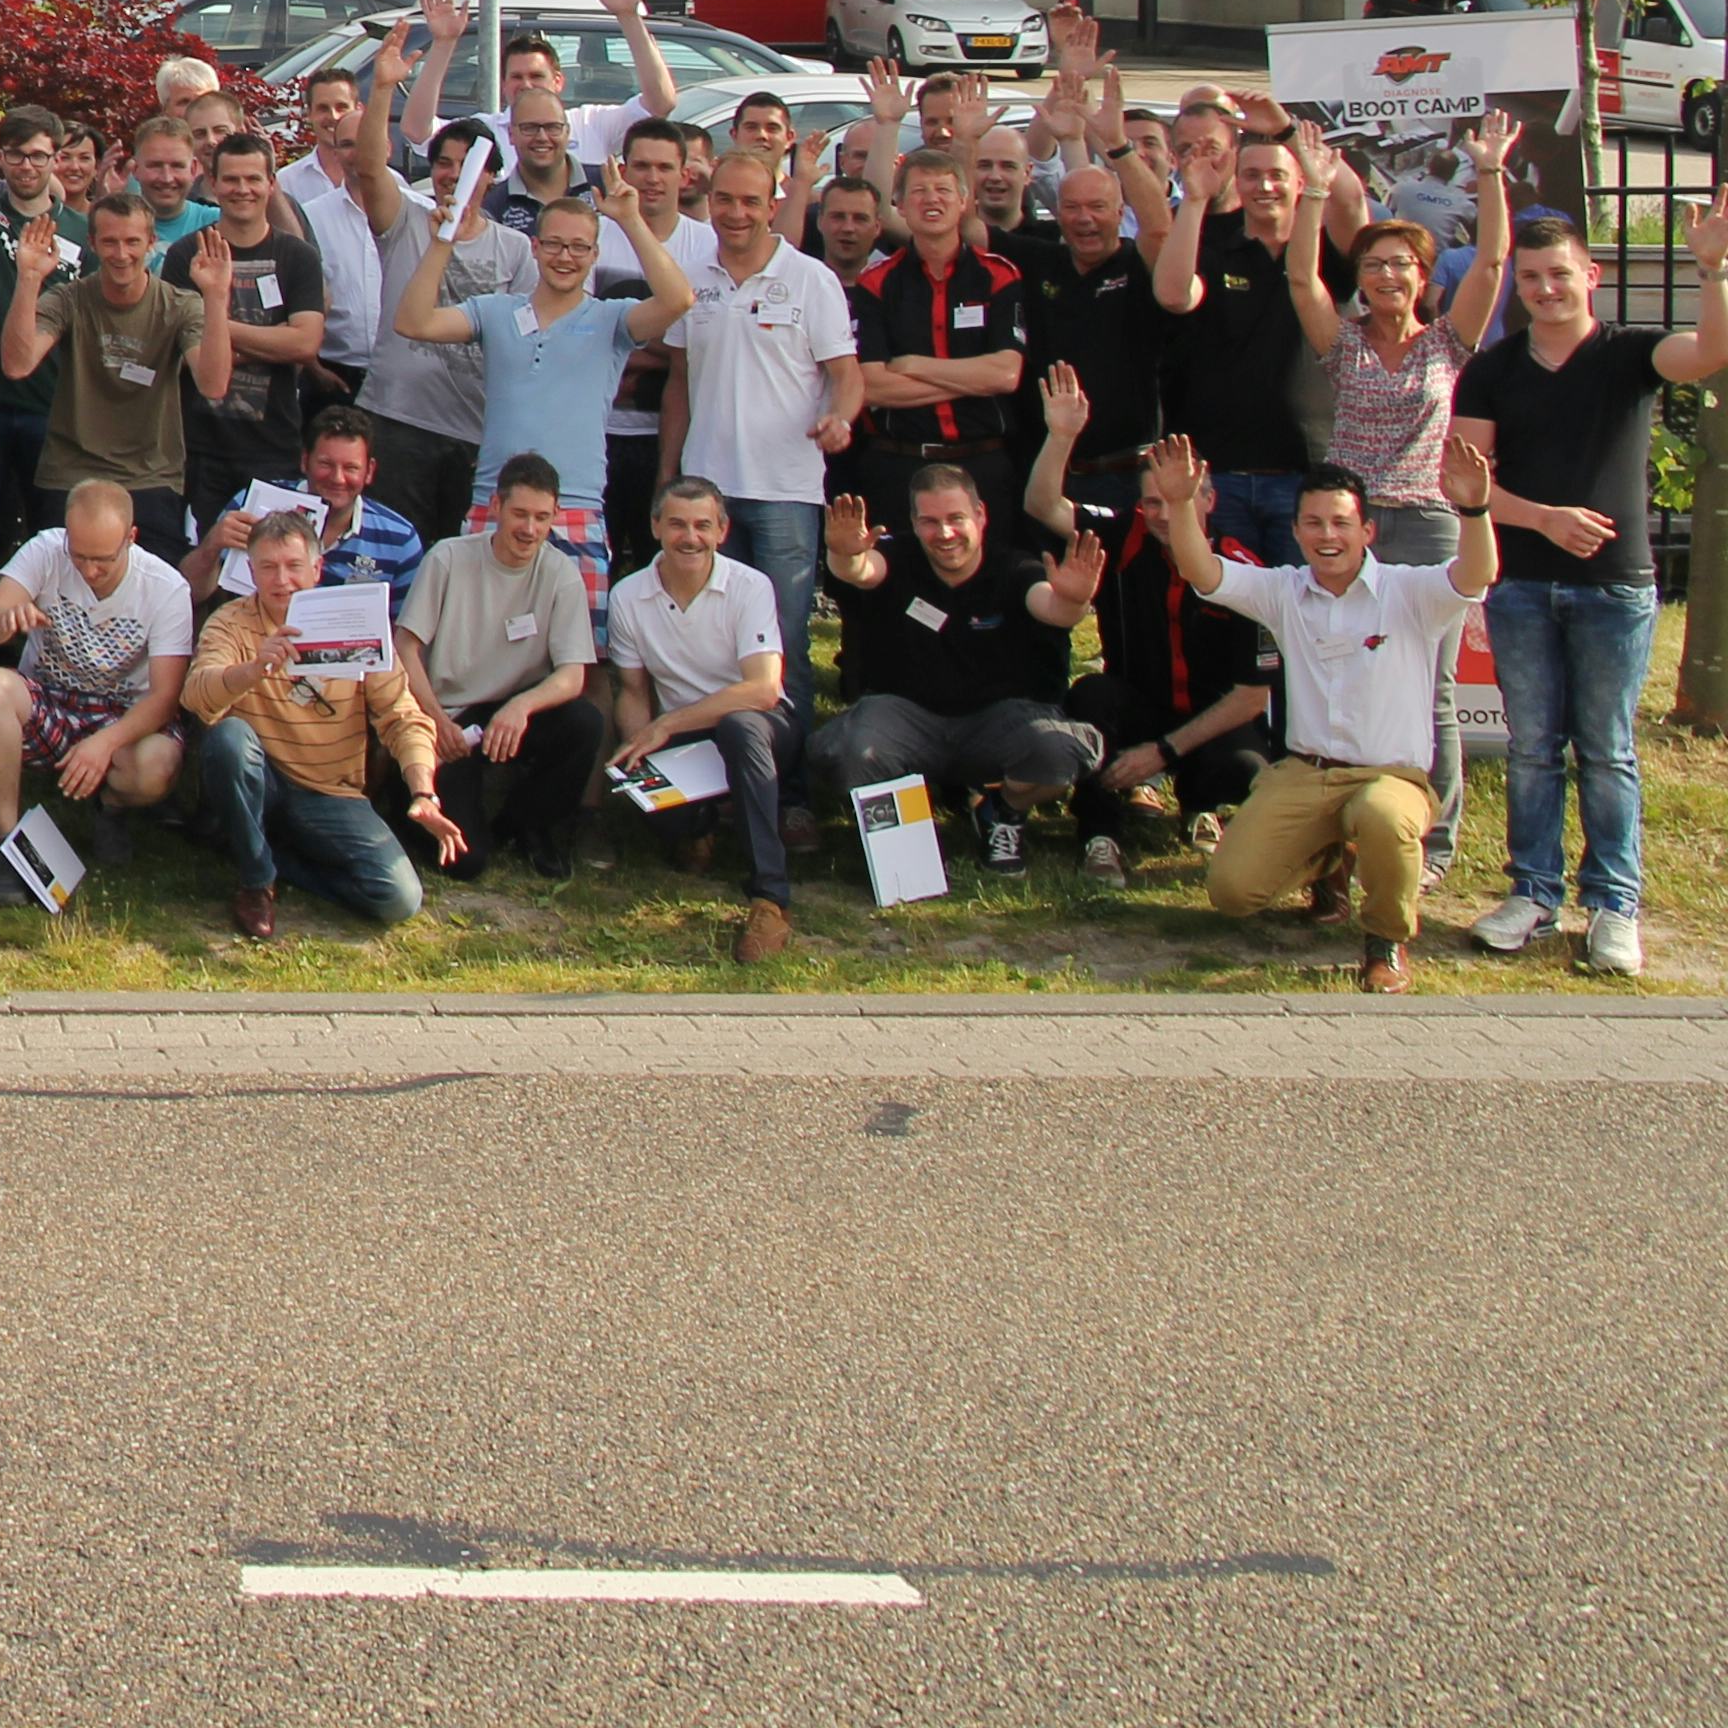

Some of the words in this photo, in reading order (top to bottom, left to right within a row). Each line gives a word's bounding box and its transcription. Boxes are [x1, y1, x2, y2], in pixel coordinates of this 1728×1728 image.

[1383, 87, 1442, 97] DIAGNOSE
[1348, 99, 1411, 118] BOOT
[1413, 95, 1480, 115] CAMP
